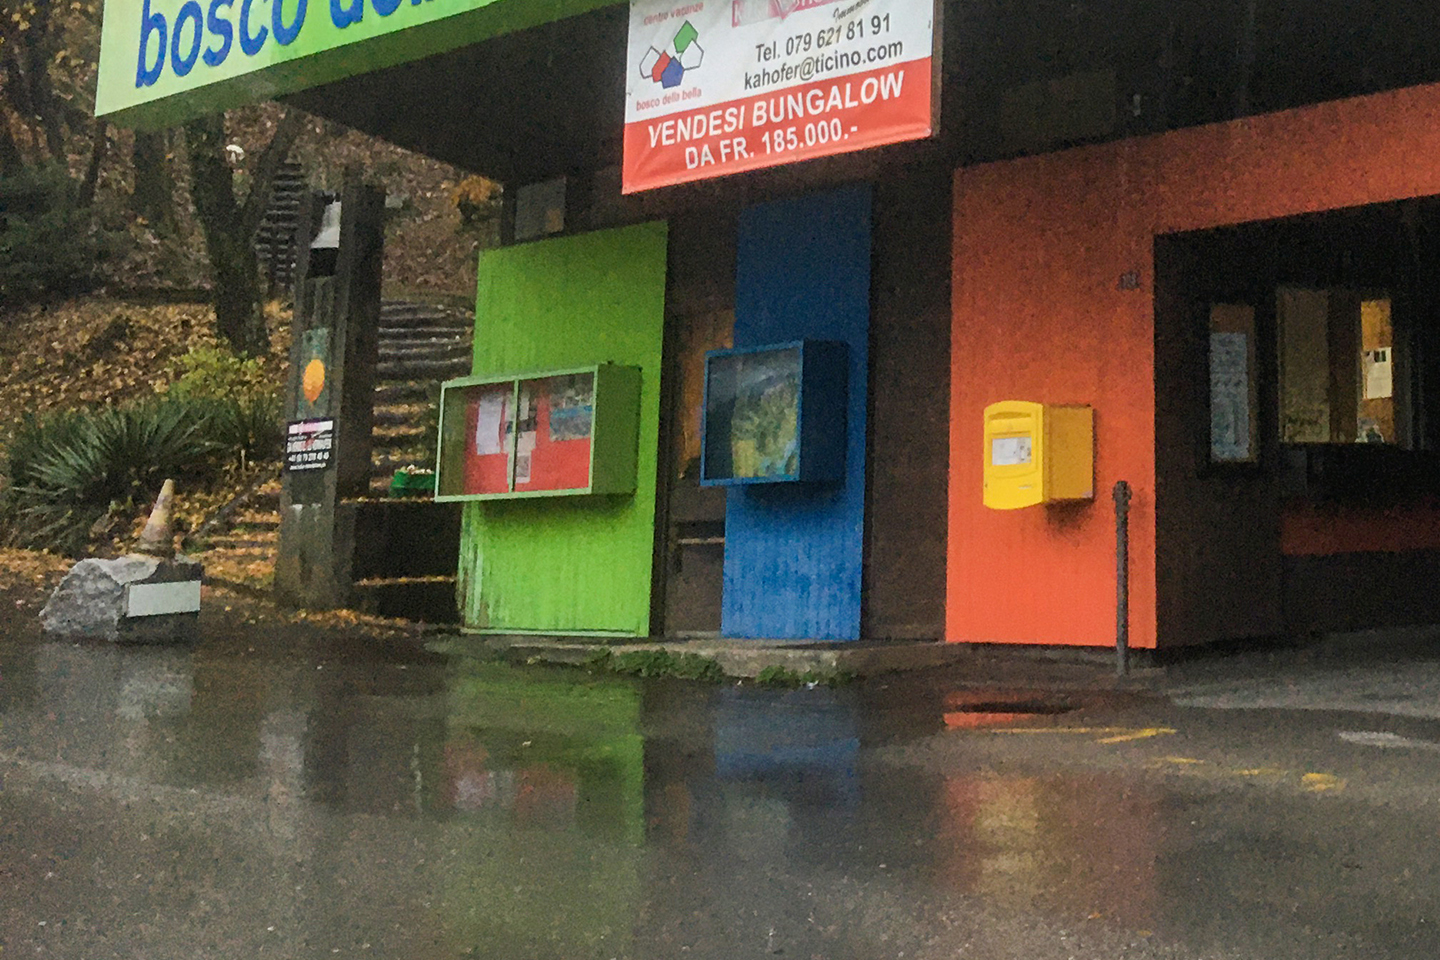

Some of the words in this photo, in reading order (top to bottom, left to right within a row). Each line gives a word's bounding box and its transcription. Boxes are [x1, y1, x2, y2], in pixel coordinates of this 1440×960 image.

[755, 41, 781, 62] Tel.
[786, 32, 812, 56] 079
[816, 25, 842, 48] 621
[846, 18, 864, 41] 81
[871, 13, 890, 35] 91
[744, 41, 903, 90] kahofer@ticino.com
[636, 98, 660, 111] bosco
[662, 91, 680, 105] della
[682, 87, 702, 100] bella
[648, 105, 746, 148] VENDESI
[752, 70, 905, 128] BUNGALOW
[685, 145, 715, 170] DA
[720, 137, 754, 163] FR.
[761, 118, 858, 155] 185.000.-
